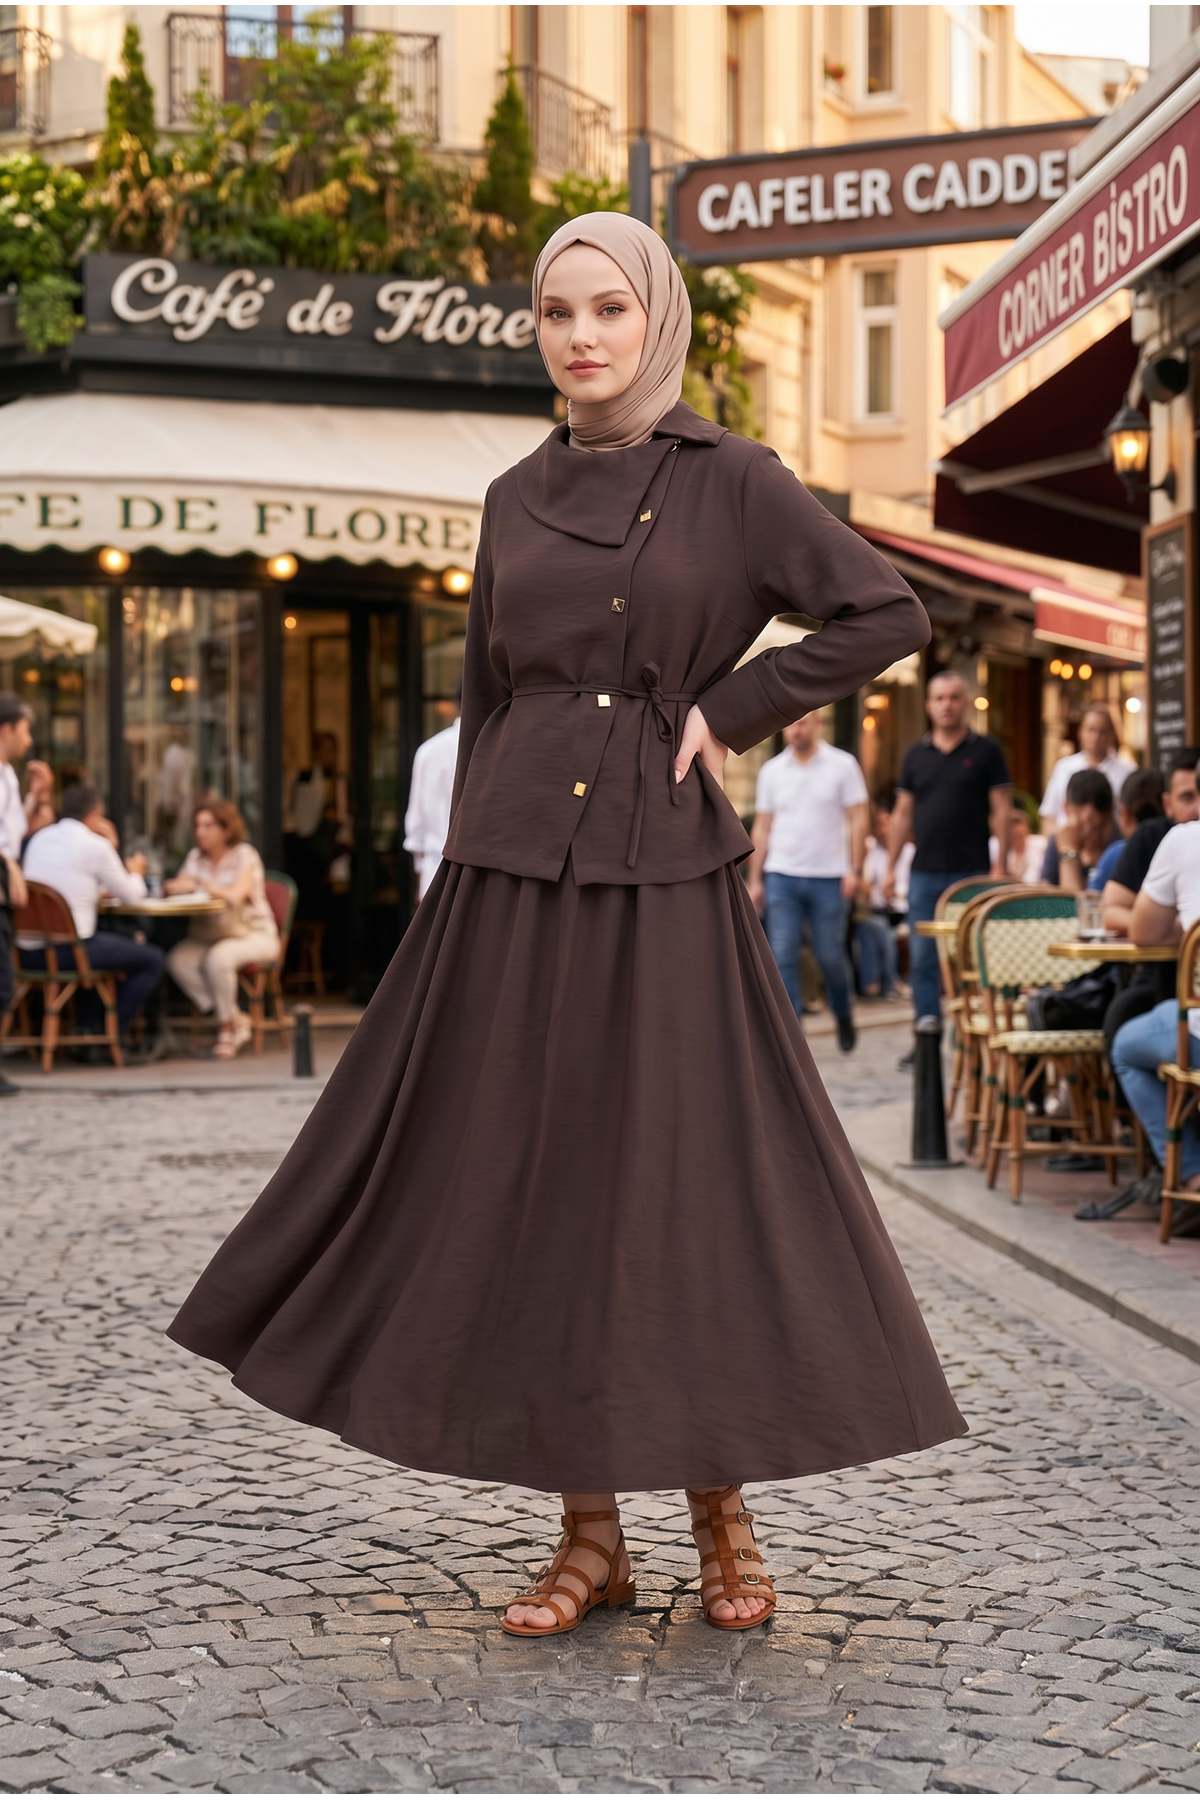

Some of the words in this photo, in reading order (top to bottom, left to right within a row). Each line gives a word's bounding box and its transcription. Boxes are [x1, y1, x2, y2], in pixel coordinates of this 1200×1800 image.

[697, 167, 892, 233] CAFELER
[902, 146, 1079, 214] CADDE
[997, 231, 1086, 359] CORNER
[1092, 144, 1188, 287] BİSTRO
[110, 257, 275, 342] Café
[286, 283, 354, 336] de
[373, 276, 535, 349] Flore
[118, 494, 219, 534] DE
[255, 501, 472, 554] FLORE
